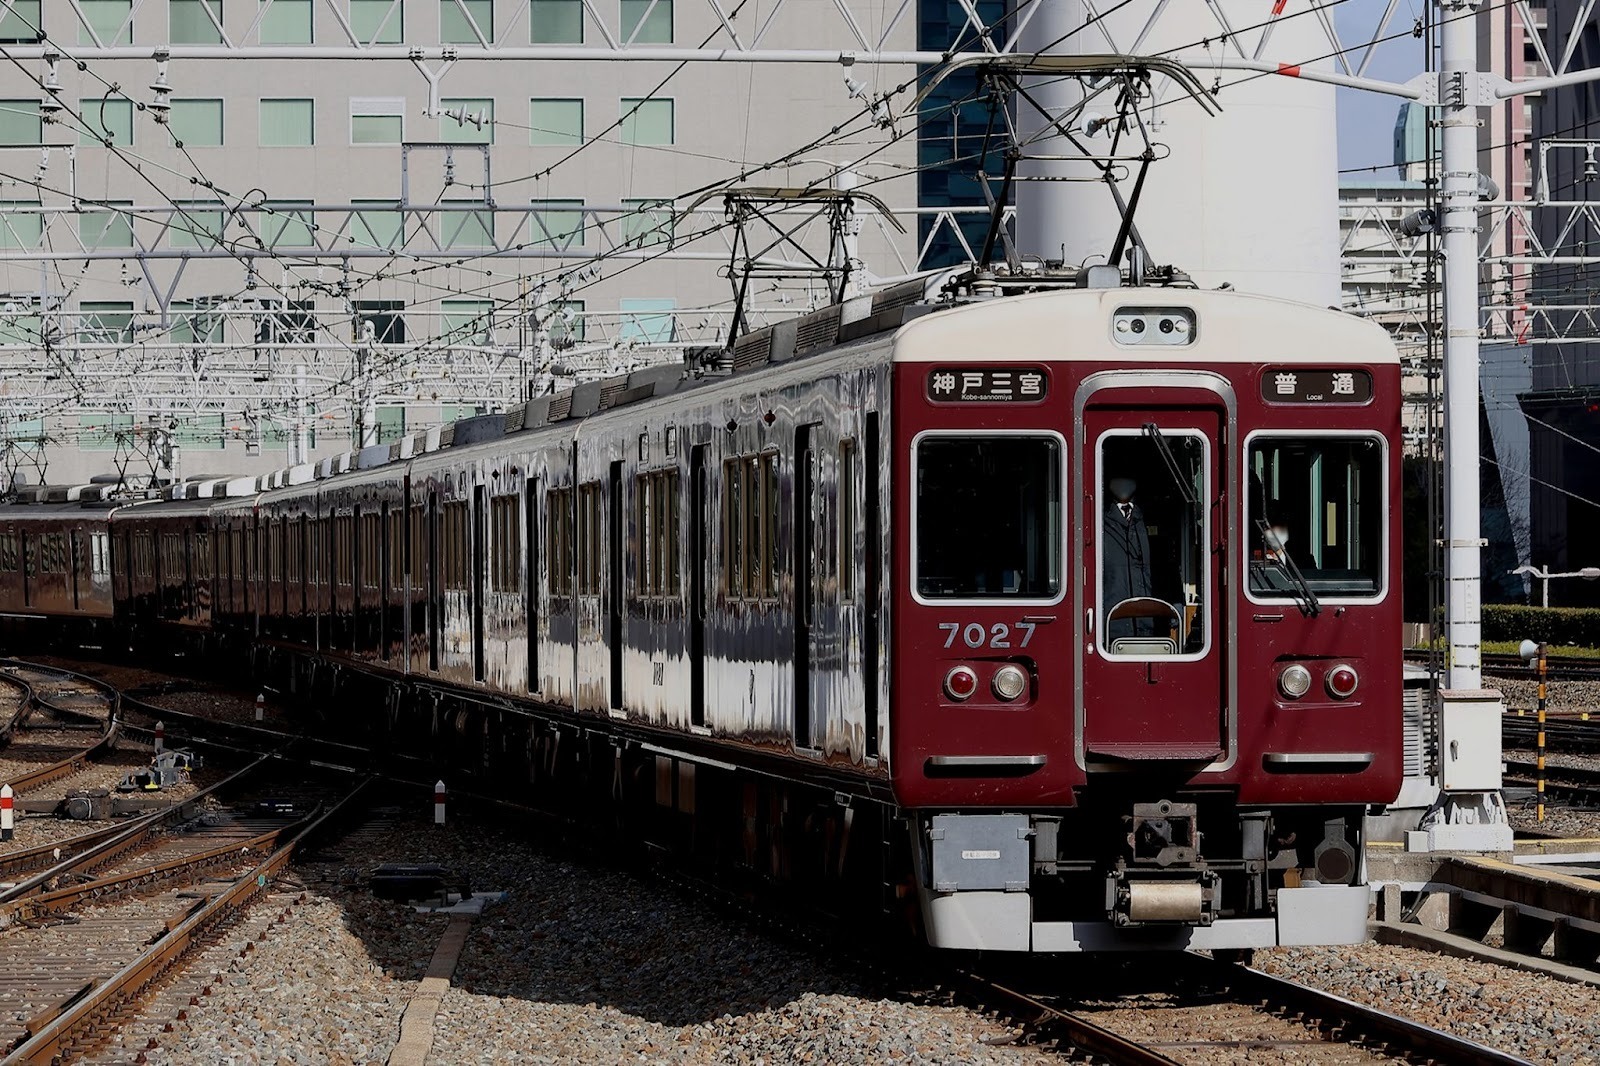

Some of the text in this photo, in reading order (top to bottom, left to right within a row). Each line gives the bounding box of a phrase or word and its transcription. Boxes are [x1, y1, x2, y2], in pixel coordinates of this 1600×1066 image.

[933, 372, 1041, 394] 神戸三宮
[961, 393, 1013, 401] Kobe-sannomiya
[938, 622, 1037, 648] 7027
